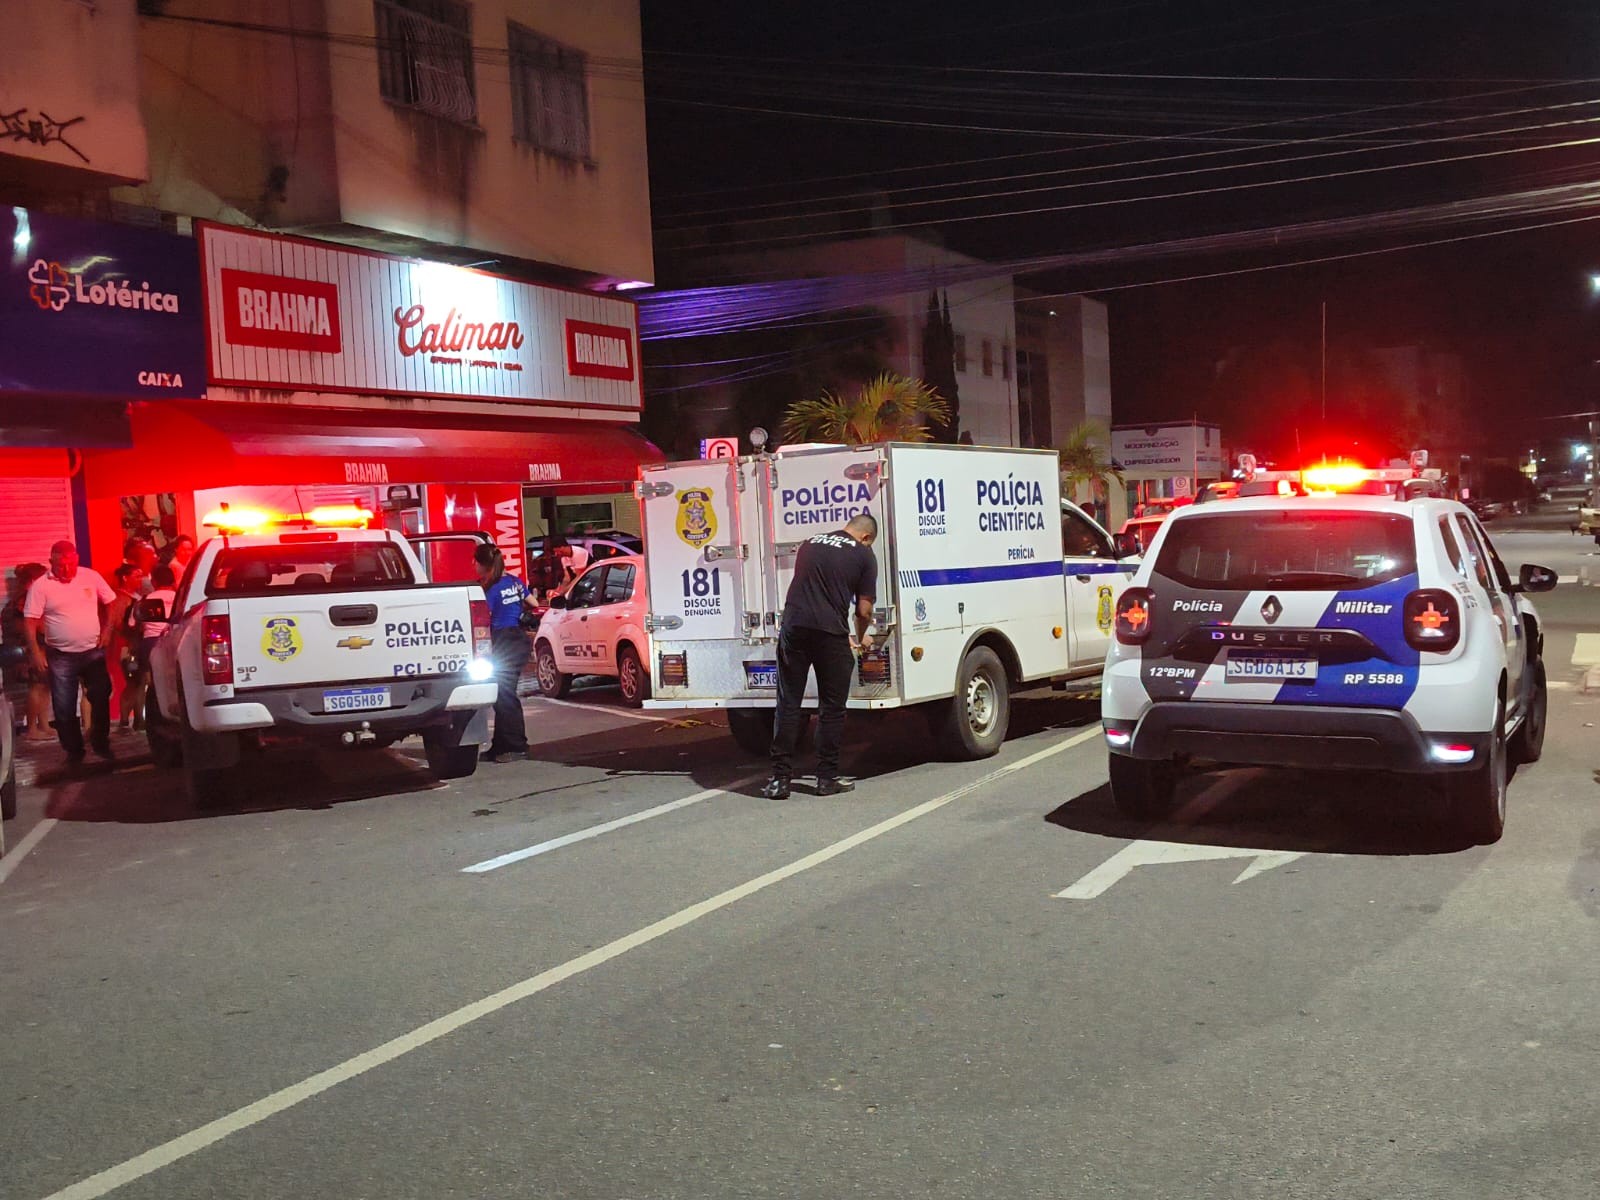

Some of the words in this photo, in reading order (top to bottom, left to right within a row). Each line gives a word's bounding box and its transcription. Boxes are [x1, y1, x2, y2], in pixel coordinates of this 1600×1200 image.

[75, 274, 179, 313] Lotérica
[238, 286, 332, 336] BRAHMA
[394, 304, 524, 357] Caliman
[574, 332, 629, 369] BRAHMA
[138, 371, 183, 388] CAIXA
[344, 462, 389, 483] BRAHMA
[528, 463, 562, 481] BRAHMA
[782, 480, 872, 507] POLÍCIA
[916, 478, 945, 514] 181
[976, 472, 1044, 506] POLÍCIA
[783, 504, 872, 525] CIENTÍFICA
[918, 514, 946, 526] DISQUE
[979, 506, 1045, 532] CIENTÍFICA
[1007, 545, 1035, 560] PERÍCIA
[681, 567, 720, 597] 181
[684, 597, 721, 608] DISQUE
[1173, 600, 1223, 612] Polícia
[1335, 601, 1392, 614] Militar
[385, 618, 464, 637] POLÍCIA
[386, 634, 466, 648] CIENTÍFICA
[1211, 632, 1332, 642] DUSTER
[236, 665, 258, 674] S10
[393, 662, 422, 676] PCI
[437, 660, 468, 673] 002
[1343, 673, 1364, 684] RP
[1368, 673, 1404, 685] 5588
[330, 694, 384, 709] SGQ5H89
